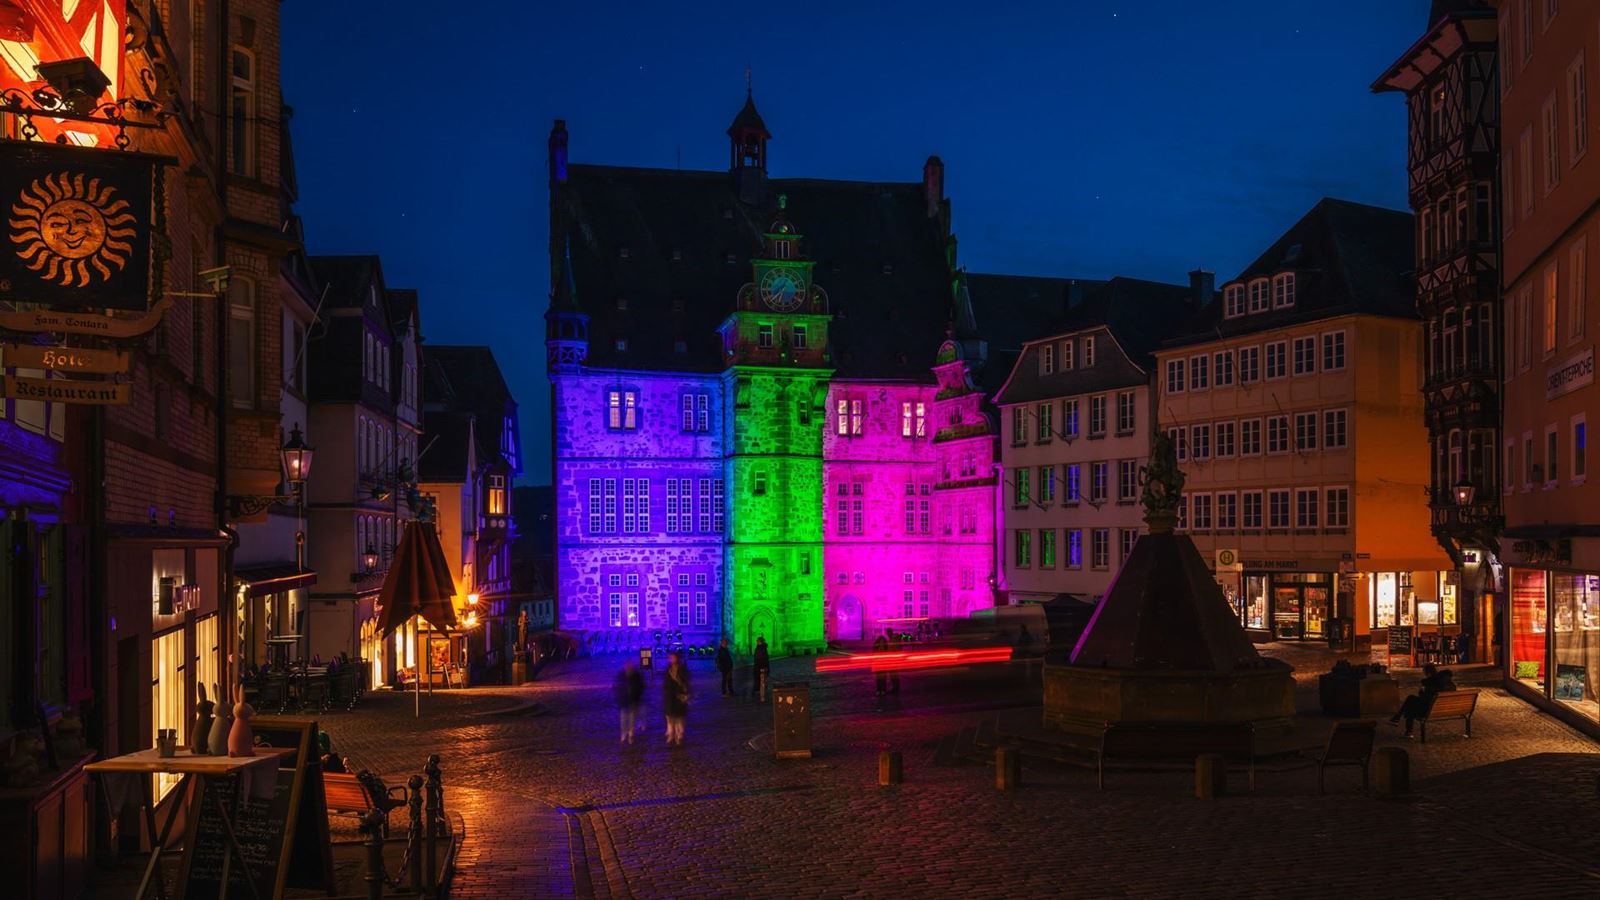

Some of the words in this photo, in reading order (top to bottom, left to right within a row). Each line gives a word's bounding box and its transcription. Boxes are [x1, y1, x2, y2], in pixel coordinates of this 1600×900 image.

[16, 381, 118, 401] Restaurant
[1264, 560, 1274, 568] AM
[1276, 560, 1298, 568] MARKT
